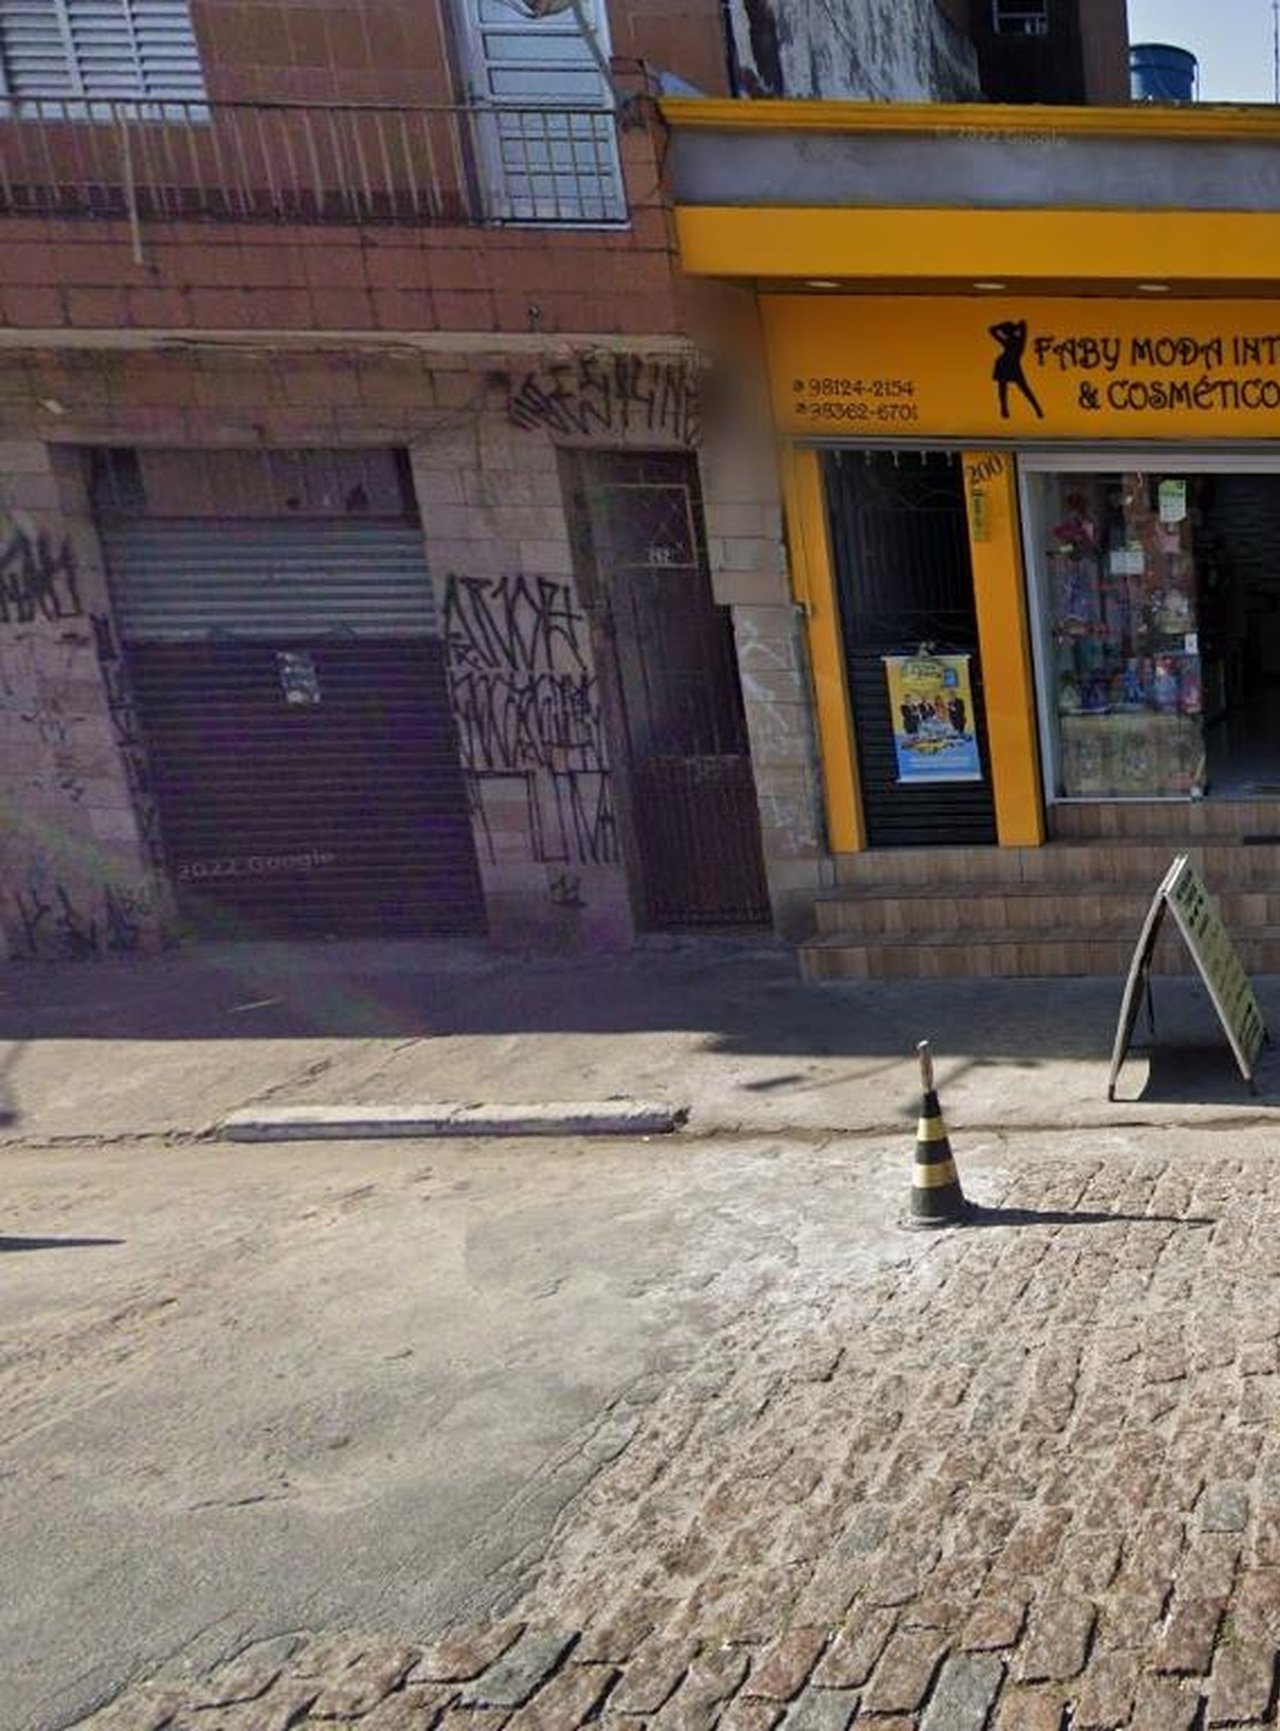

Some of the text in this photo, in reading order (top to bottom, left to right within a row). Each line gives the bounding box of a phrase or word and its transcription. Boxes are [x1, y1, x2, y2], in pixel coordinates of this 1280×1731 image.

[1034, 336, 1121, 371] FABY
[1131, 335, 1224, 370] MODA
[1078, 380, 1101, 410] &
